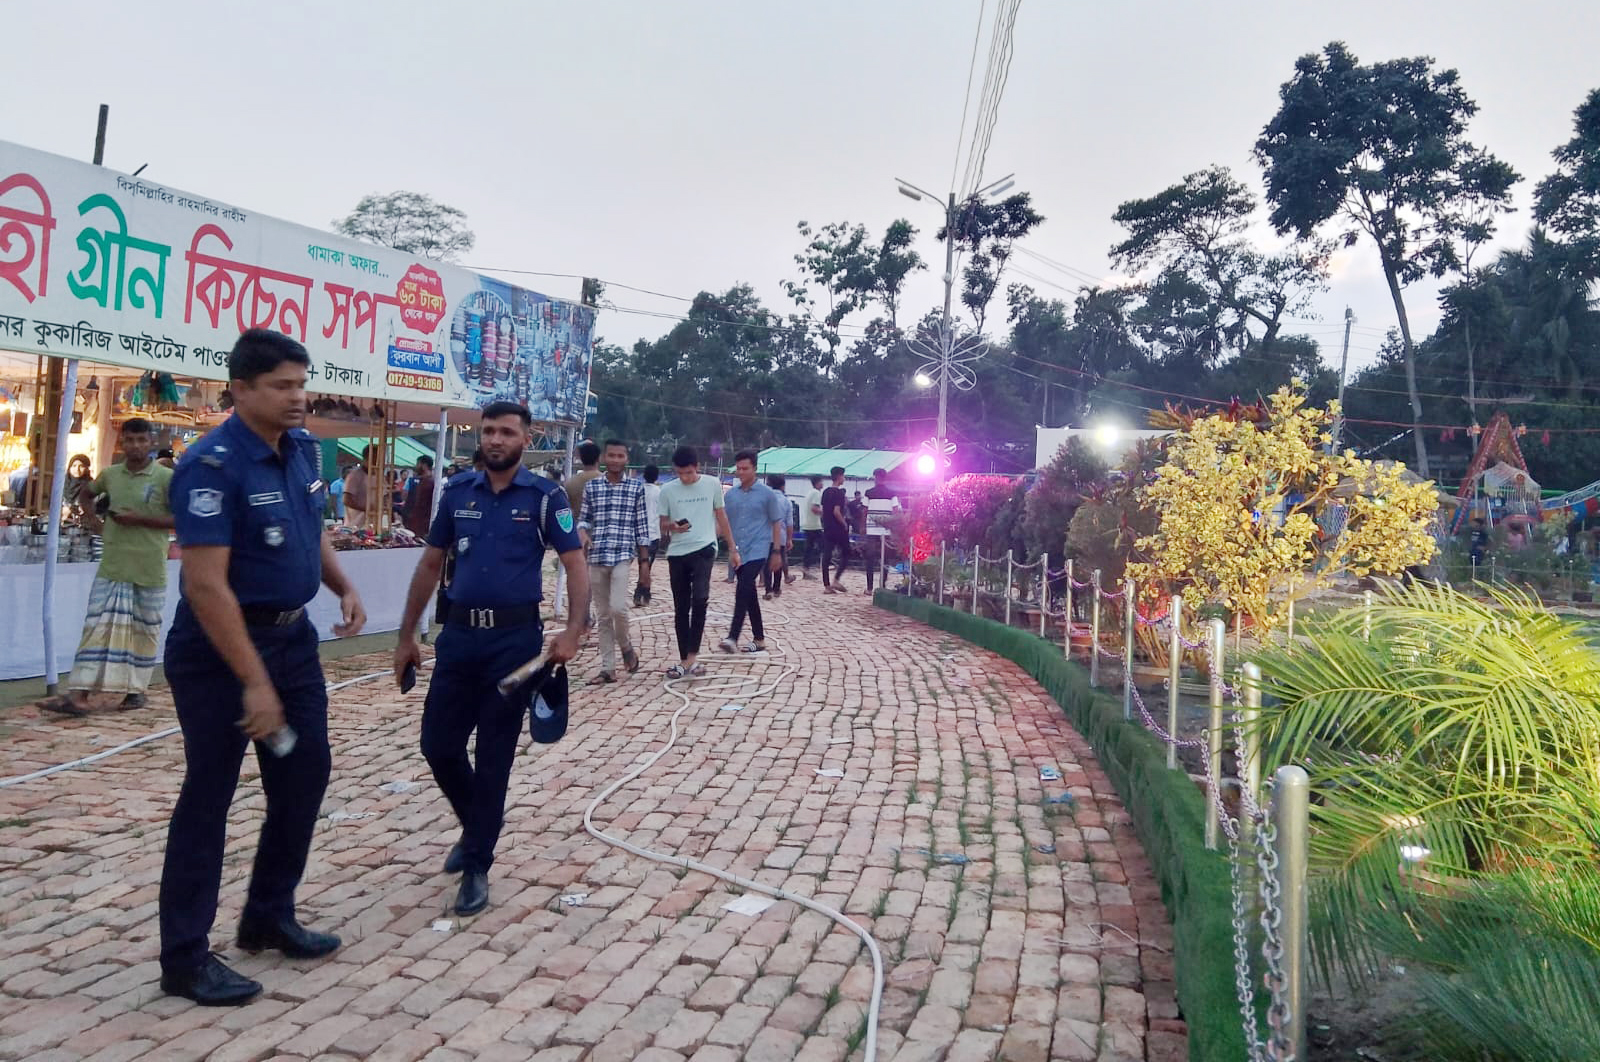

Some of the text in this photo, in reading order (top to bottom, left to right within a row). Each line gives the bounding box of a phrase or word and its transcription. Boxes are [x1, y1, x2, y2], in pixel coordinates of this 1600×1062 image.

[307, 244, 345, 268] ধামাকা
[66, 193, 171, 319] গ্রীন
[184, 223, 314, 344] কিচেন
[322, 282, 401, 354] সপ
[419, 287, 444, 313] টাকা
[32, 320, 114, 351] কুকারিজ
[118, 330, 187, 363] আইটেম
